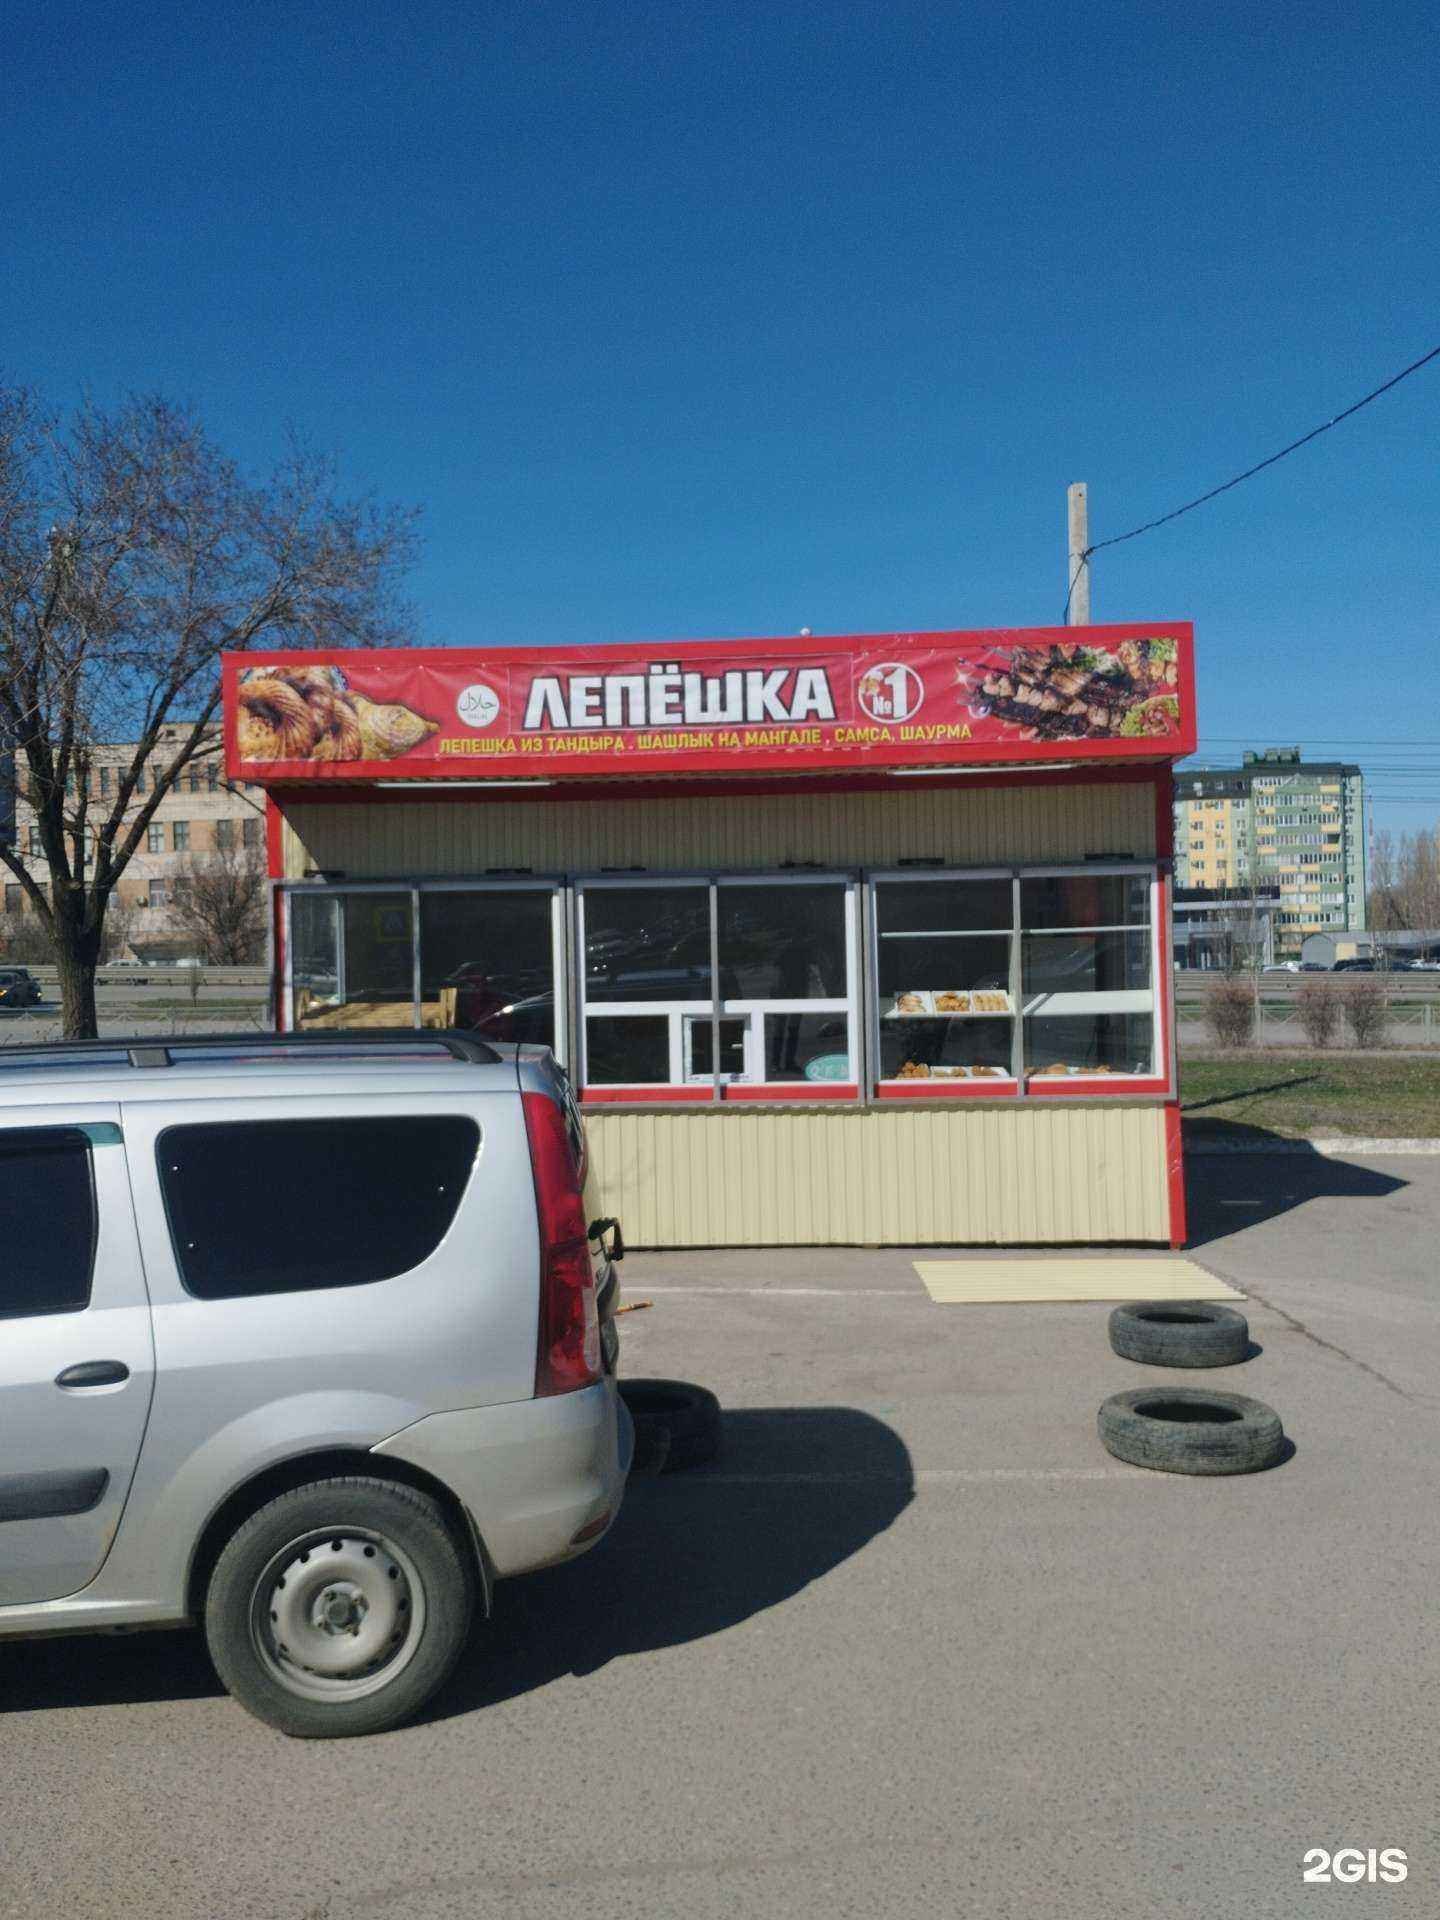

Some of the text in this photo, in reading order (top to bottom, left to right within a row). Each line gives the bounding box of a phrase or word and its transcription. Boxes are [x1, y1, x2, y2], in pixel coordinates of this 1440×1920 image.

[523, 663, 837, 729] ЛЕПЁШКА
[439, 737, 515, 753] ЛЕПЕШКА
[520, 736, 543, 751] ИЗ
[637, 732, 714, 750] ШАШЛЫК
[718, 730, 740, 747] НА
[744, 728, 821, 746] МАНГАЛЕ
[899, 723, 973, 741] ШАУРМА
